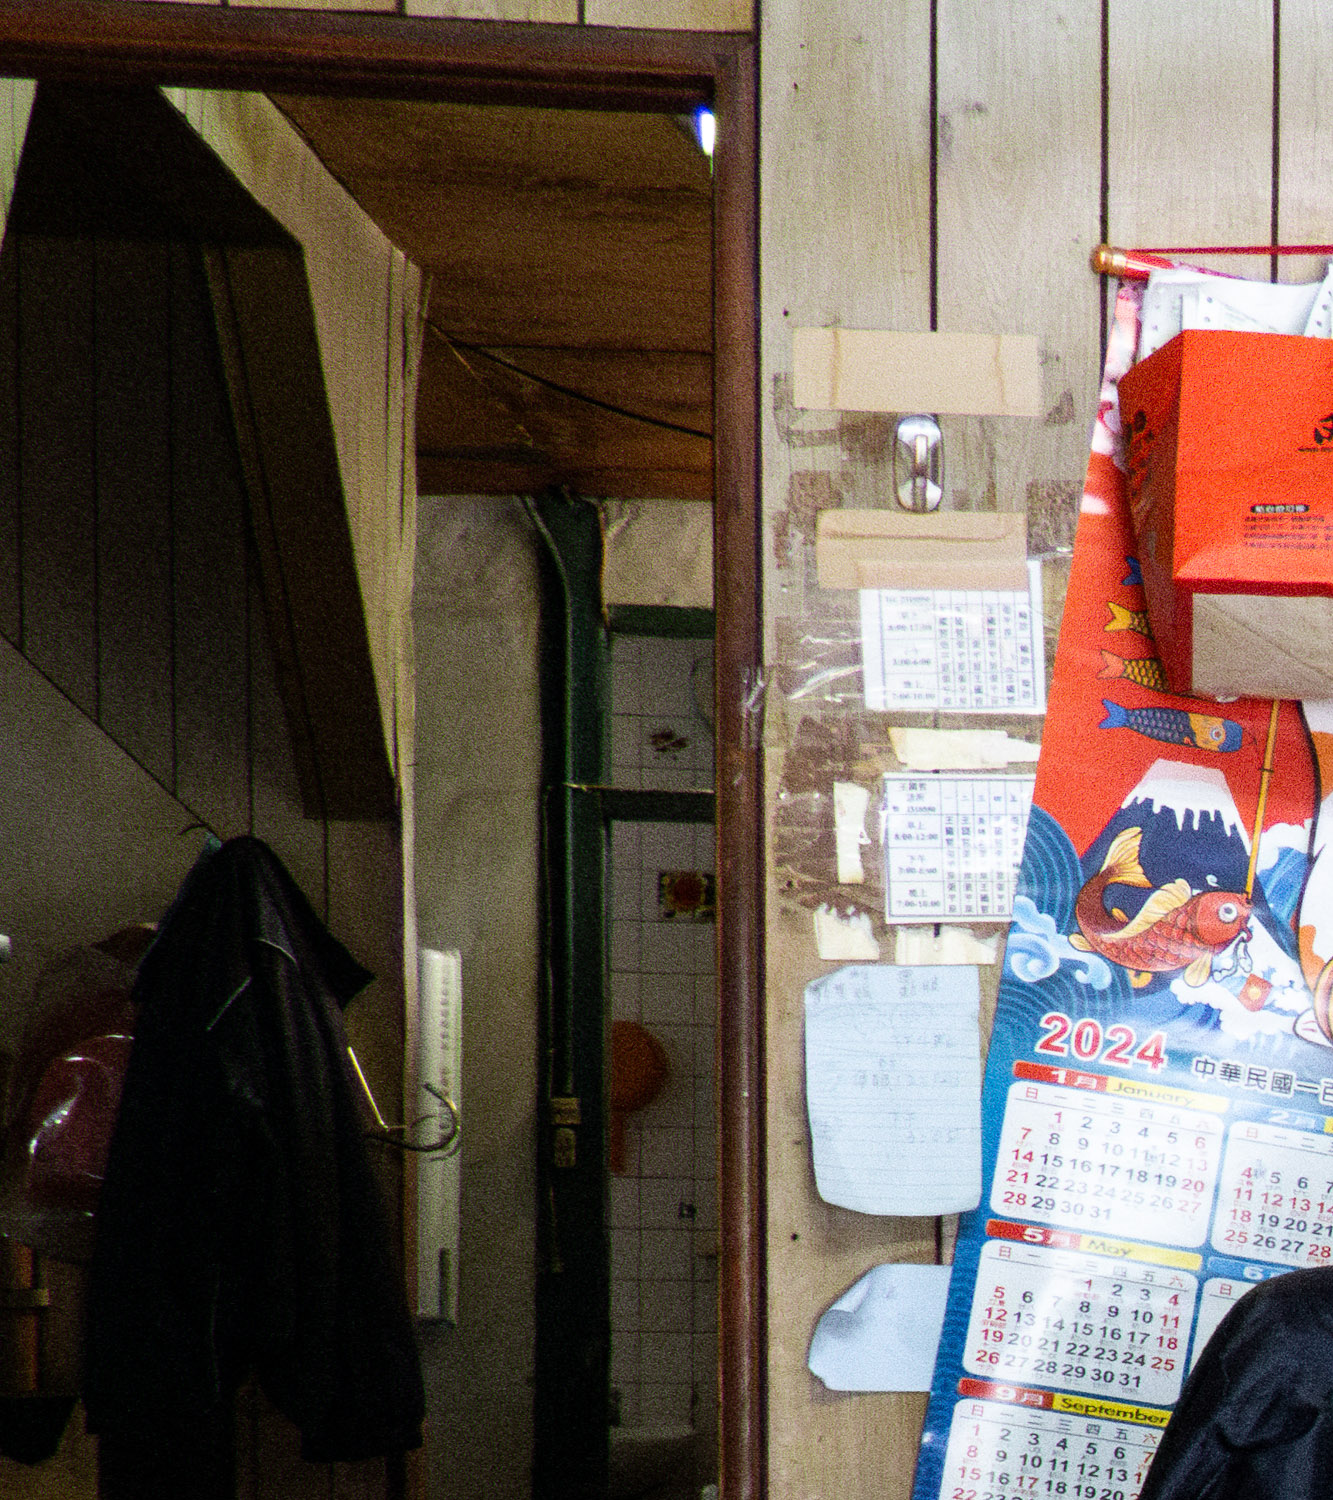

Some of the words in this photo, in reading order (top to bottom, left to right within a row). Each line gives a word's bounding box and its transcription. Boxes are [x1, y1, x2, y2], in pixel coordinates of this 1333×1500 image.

[1035, 1012, 1167, 1073] 2024
[1050, 1069, 1097, 1089] 1月
[1114, 1082, 1195, 1107] January
[1241, 1167, 1252, 1178] 4
[1270, 1172, 1281, 1183] 5
[1298, 1177, 1308, 1188] 6
[1234, 1188, 1252, 1201] 11
[1262, 1192, 1282, 1206] 12
[1289, 1197, 1310, 1211] 13
[1230, 1209, 1251, 1222] 18
[1258, 1213, 1279, 1227] 19
[1284, 1218, 1307, 1232] 20
[1312, 1223, 1333, 1237] 21
[1023, 1227, 1071, 1247] 5月
[1088, 1238, 1132, 1256] May
[1225, 1230, 1248, 1243] 25
[1253, 1234, 1276, 1248] 26
[1281, 1239, 1304, 1253] 27
[1308, 1244, 1331, 1258] 28
[996, 1386, 1043, 1403] 9月
[1061, 1397, 1168, 1425] September
[1000, 1429, 1011, 1441] 2
[1028, 1433, 1040, 1445] 3
[1056, 1438, 1068, 1450] 4
[1086, 1443, 1098, 1454] 5
[1114, 1447, 1125, 1459] 6
[1143, 1452, 1154, 1463] 7
[967, 1445, 978, 1458] 8
[996, 1450, 1007, 1462] 9
[1019, 1454, 1042, 1468] 10
[1049, 1459, 1069, 1472] 11
[1077, 1464, 1100, 1477] 12
[1106, 1468, 1128, 1482] 13
[958, 1467, 981, 1481] 15
[988, 1472, 1010, 1486] 16
[1016, 1476, 1039, 1489] 17
[1044, 1481, 1067, 1493] 18
[1074, 1485, 1096, 1498] 19
